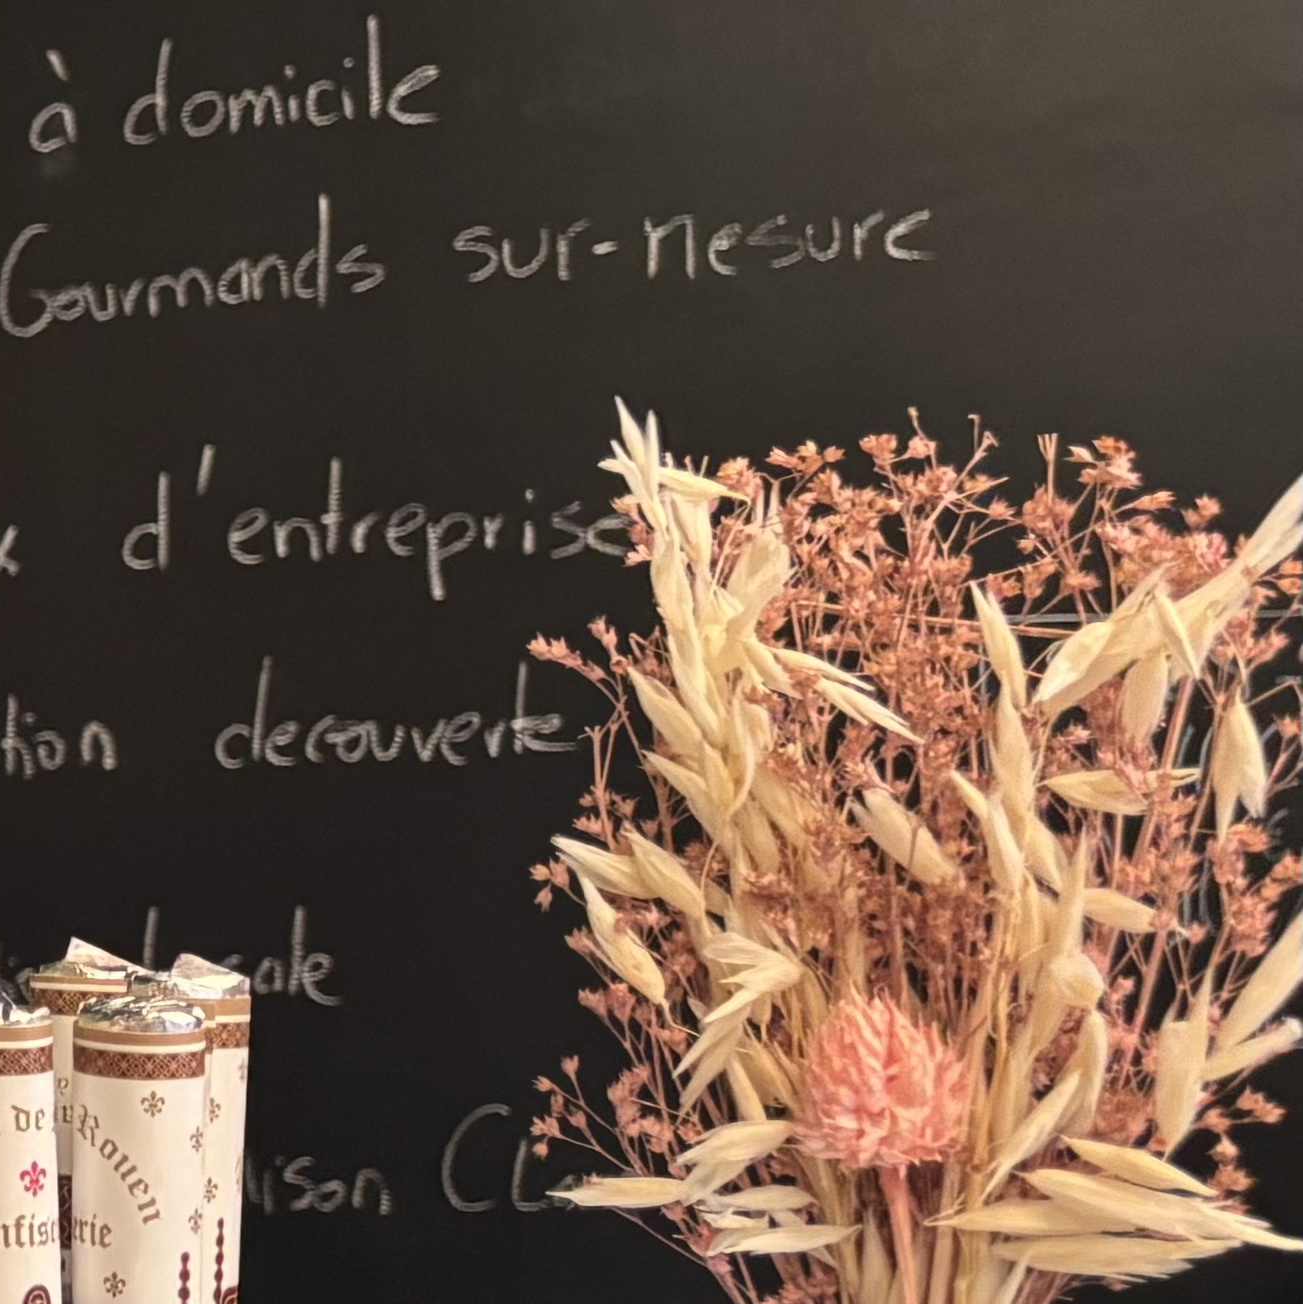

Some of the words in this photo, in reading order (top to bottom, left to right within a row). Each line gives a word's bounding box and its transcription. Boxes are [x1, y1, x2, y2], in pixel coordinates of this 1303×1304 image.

[28, 48, 77, 154] à
[123, 14, 441, 146] domicile
[11, 1105, 45, 1132] de
[77, 1105, 162, 1226] Rouen
